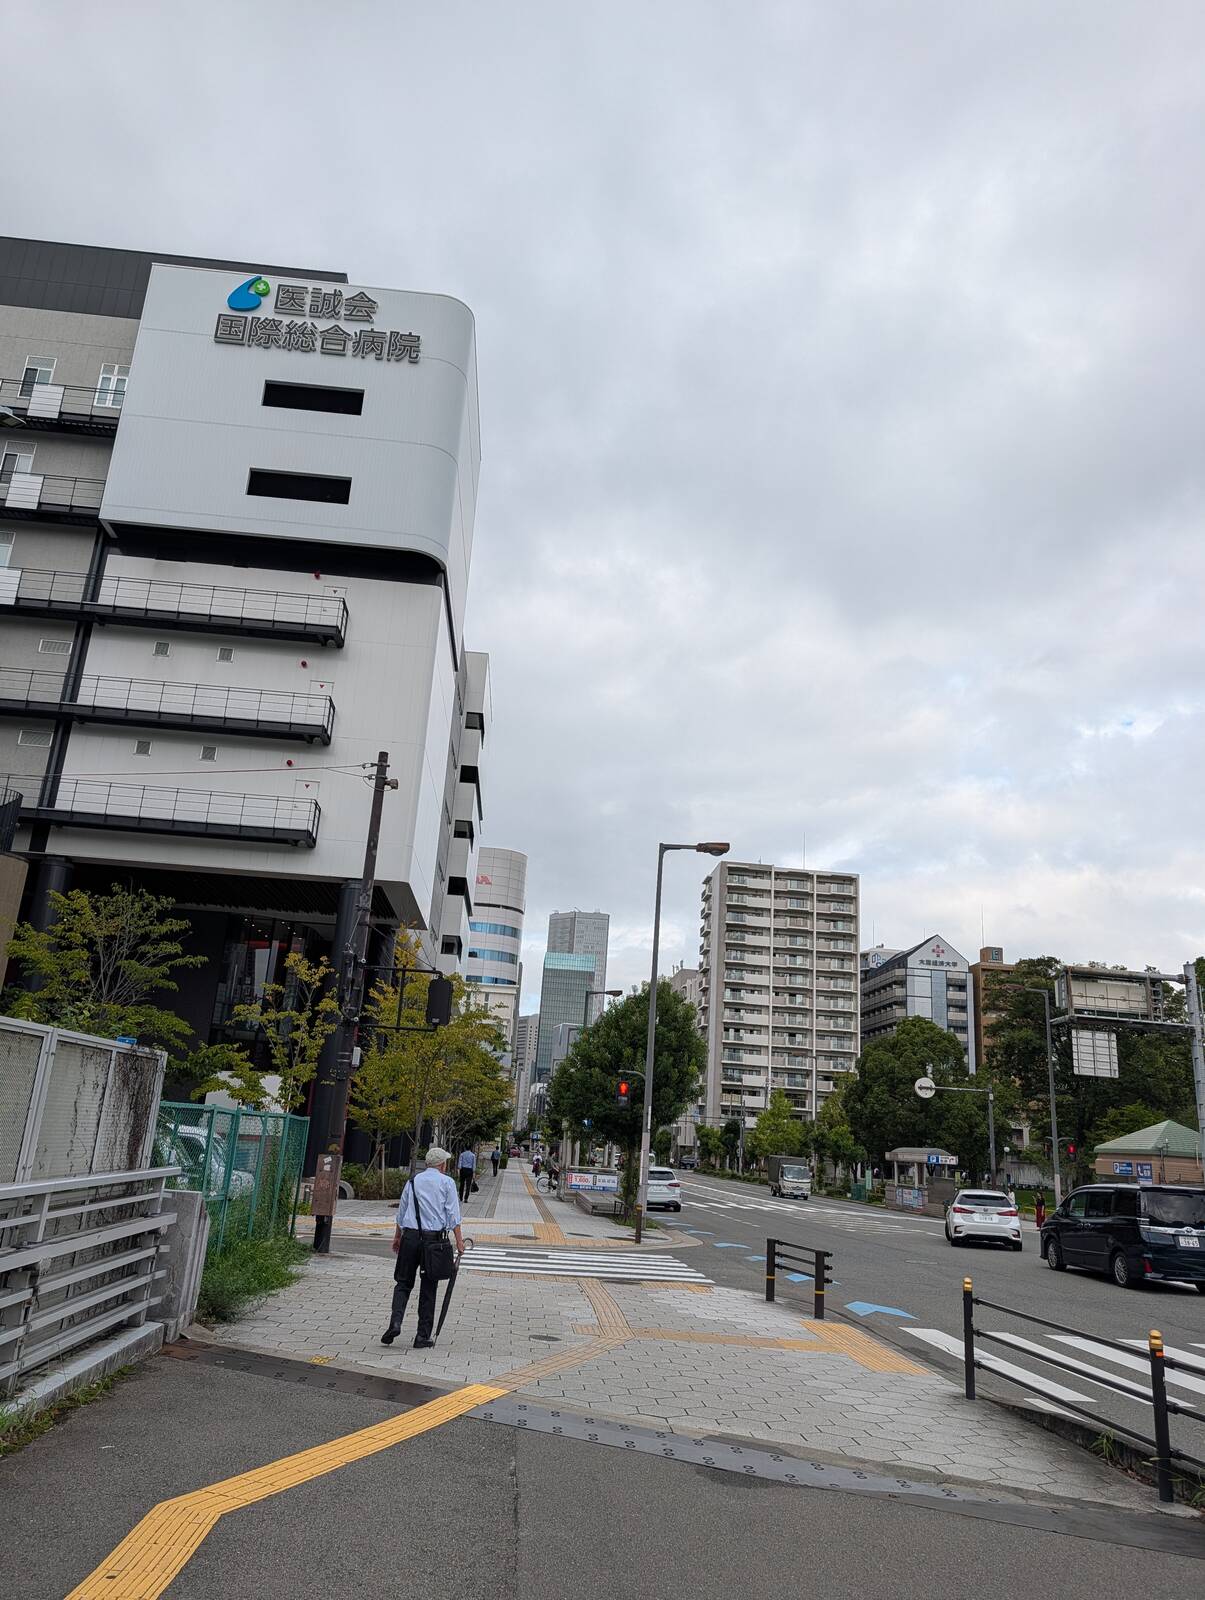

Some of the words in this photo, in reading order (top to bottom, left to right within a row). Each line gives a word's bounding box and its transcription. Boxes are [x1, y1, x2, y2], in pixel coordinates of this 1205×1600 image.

[274, 284, 378, 323] 医誠会
[214, 313, 421, 363] 国際総合病院
